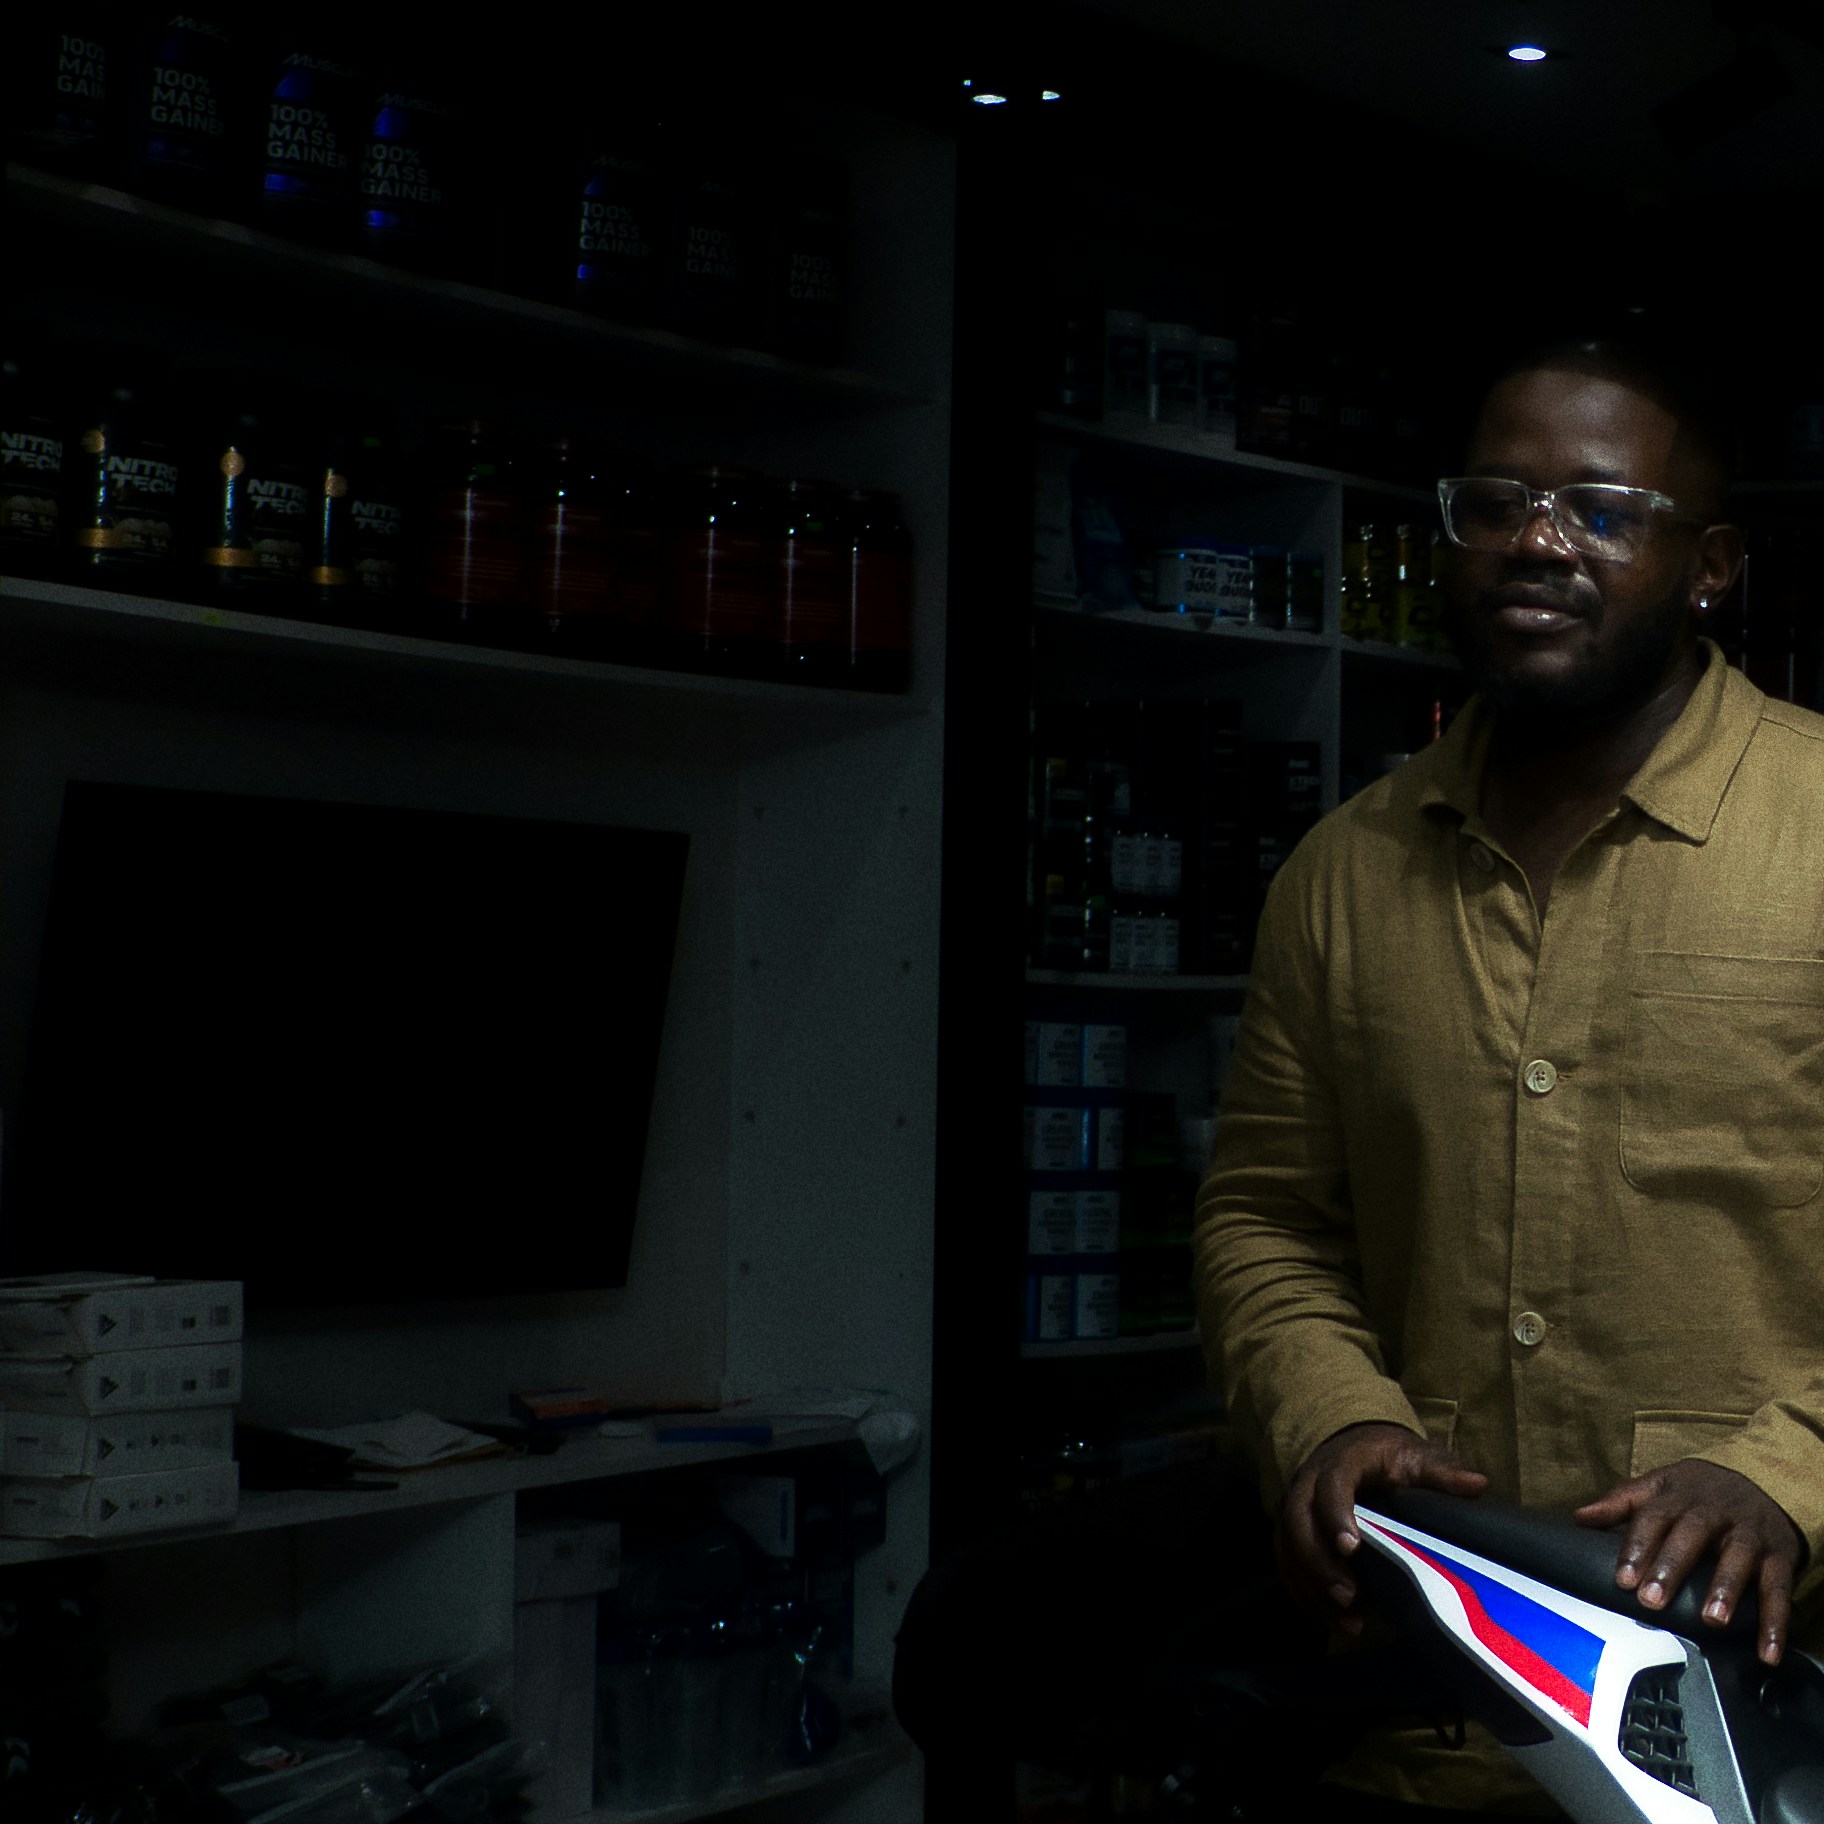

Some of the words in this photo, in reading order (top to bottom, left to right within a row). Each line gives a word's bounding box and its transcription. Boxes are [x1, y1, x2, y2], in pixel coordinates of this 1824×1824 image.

[269, 102, 328, 130] 100%
[267, 122, 337, 150] MASS
[265, 140, 348, 170] GAINER
[361, 160, 430, 186] MASS
[360, 177, 443, 207] GAINER
